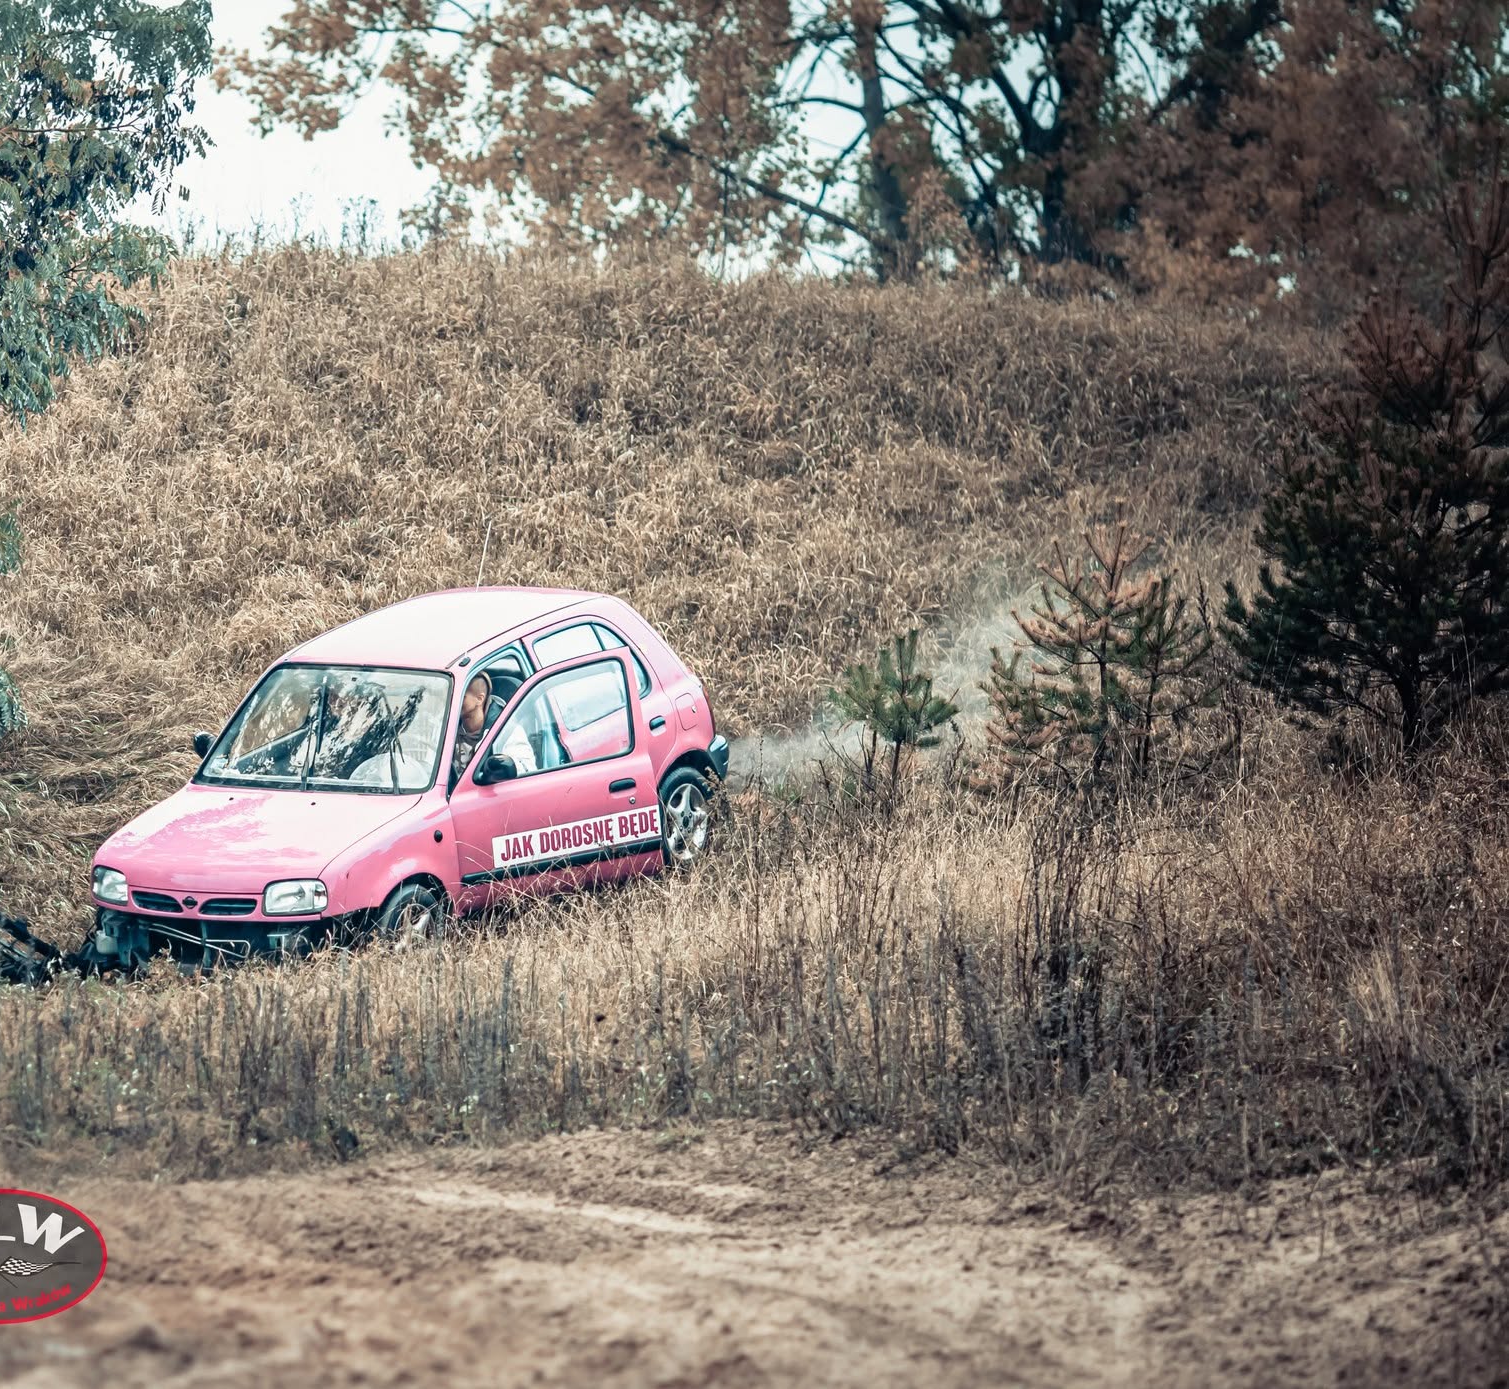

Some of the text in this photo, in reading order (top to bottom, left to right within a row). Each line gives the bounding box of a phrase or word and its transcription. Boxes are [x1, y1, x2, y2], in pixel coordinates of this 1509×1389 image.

[501, 809, 659, 862] JAK DOROSNĘ BĘDĘ
